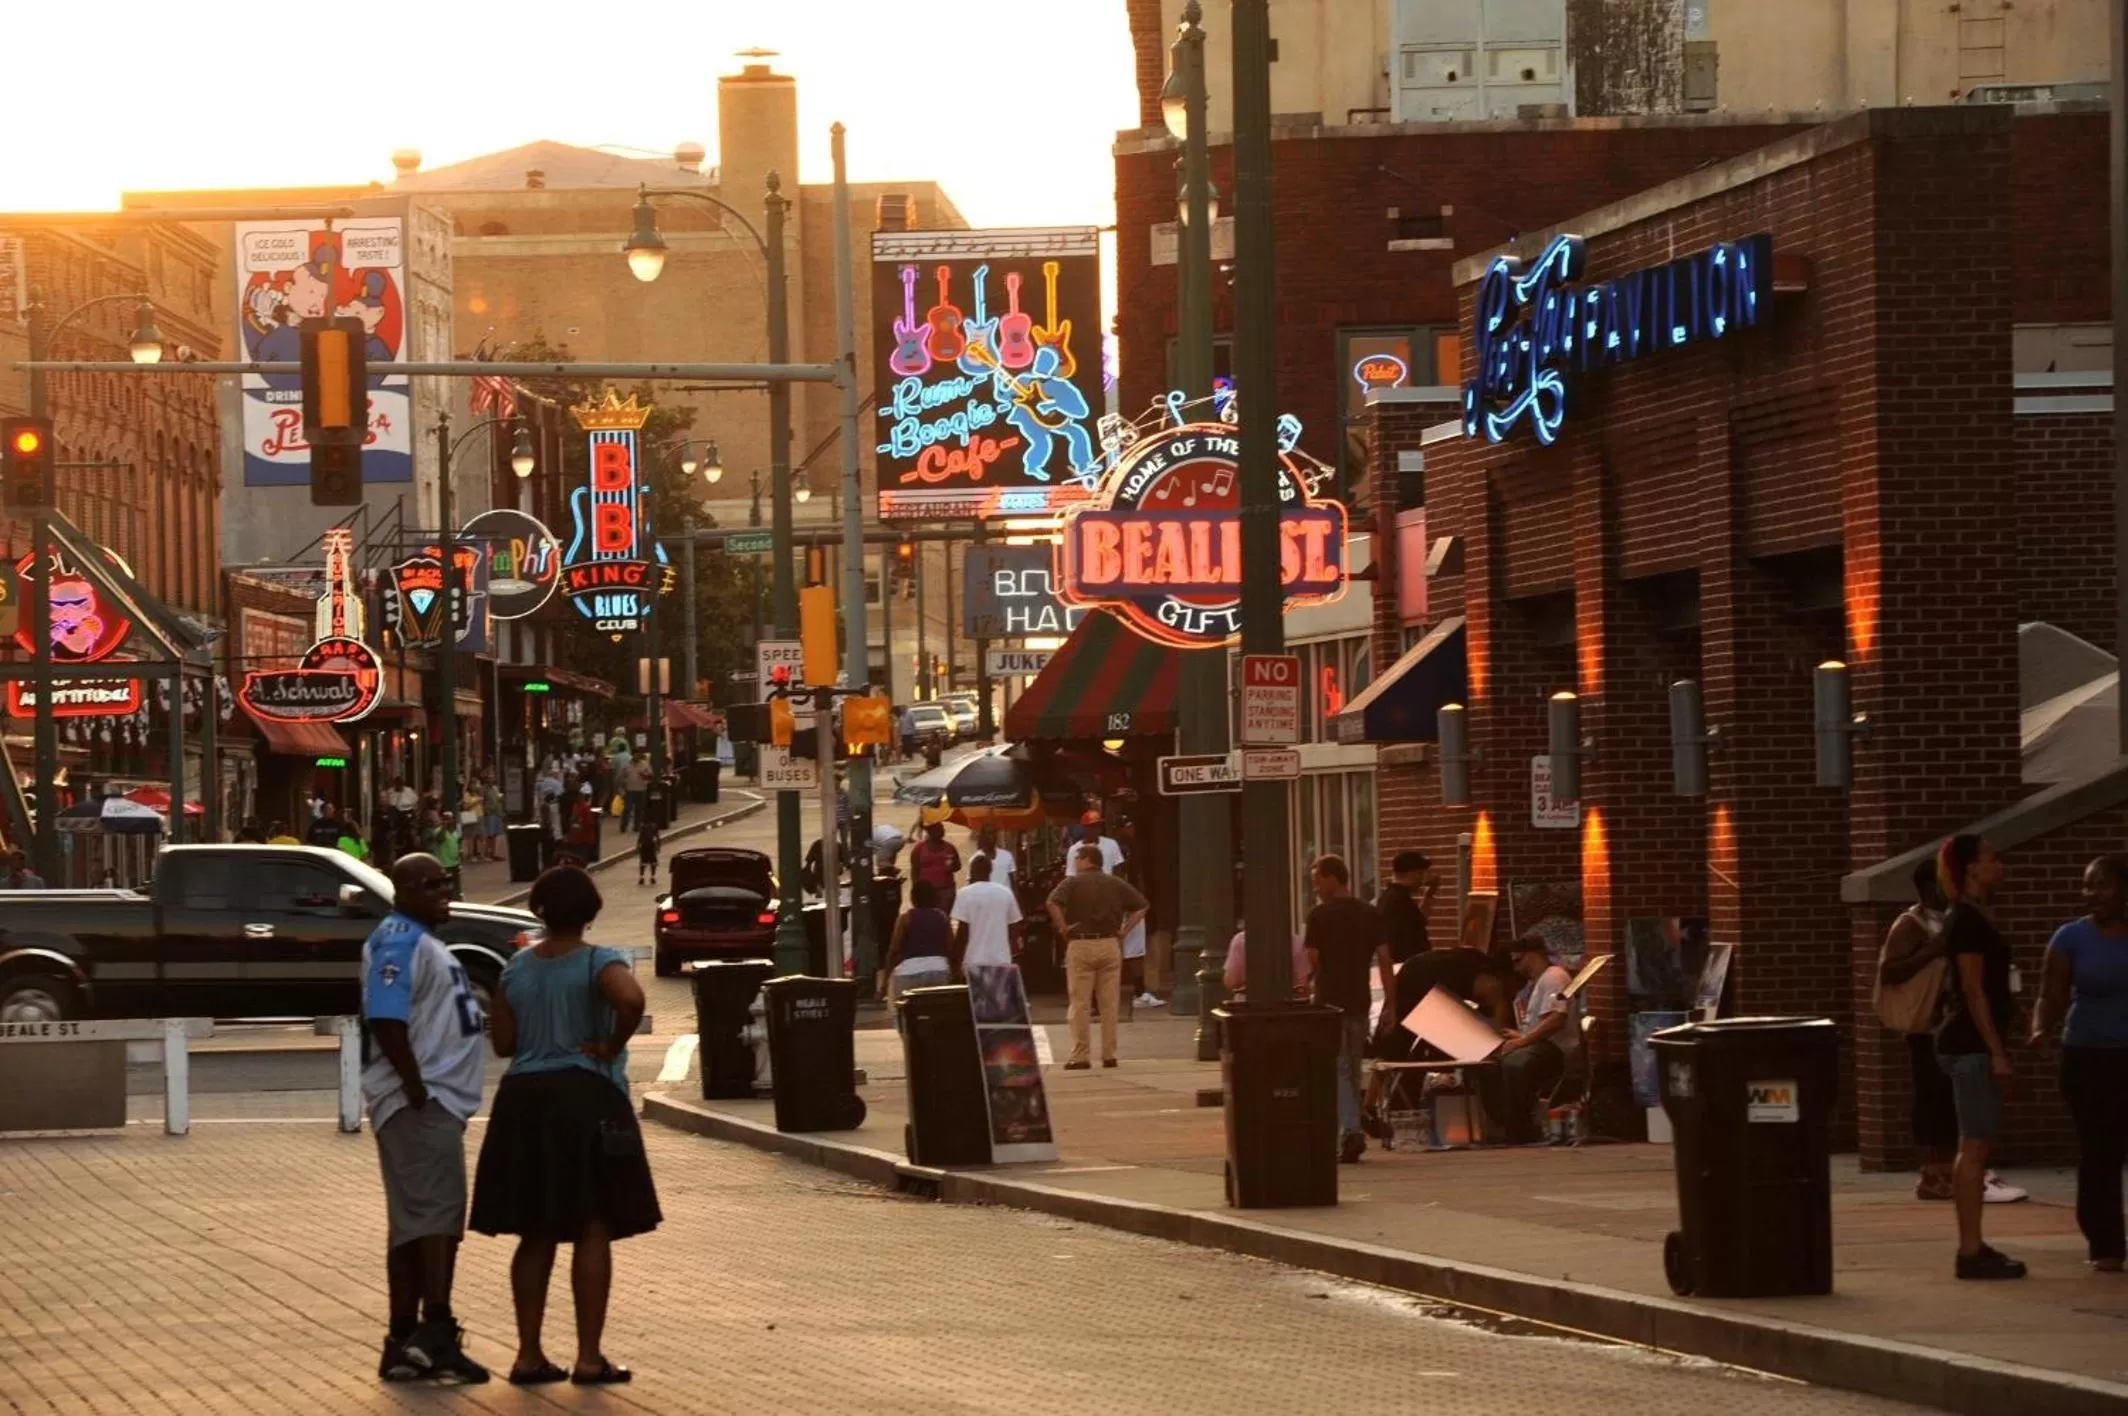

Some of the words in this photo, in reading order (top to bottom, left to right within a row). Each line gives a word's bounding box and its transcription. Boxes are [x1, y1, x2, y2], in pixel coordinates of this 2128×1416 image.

[347, 236, 399, 249] ARRESTING
[1581, 242, 1757, 367] PAVILION
[265, 390, 303, 402] DRIN
[891, 398, 997, 459] Boogie
[917, 435, 1001, 483] Cafe
[1121, 452, 1168, 501] HOME
[1171, 438, 1196, 456] OF
[1204, 436, 1240, 456] THE
[728, 538, 773, 551] Second
[994, 570, 1064, 597] BLU
[594, 593, 639, 617] BLUES
[595, 619, 638, 630] CLUB
[762, 648, 801, 661] SPEE
[996, 654, 1047, 671] JUKE
[1254, 661, 1289, 682] NO
[273, 675, 356, 701] Schwab
[1248, 690, 1293, 701] PARKING
[1107, 712, 1130, 731] 182
[1248, 719, 1295, 730] ANYTIME
[766, 769, 812, 782] BUSES
[1175, 767, 1205, 782] ONE
